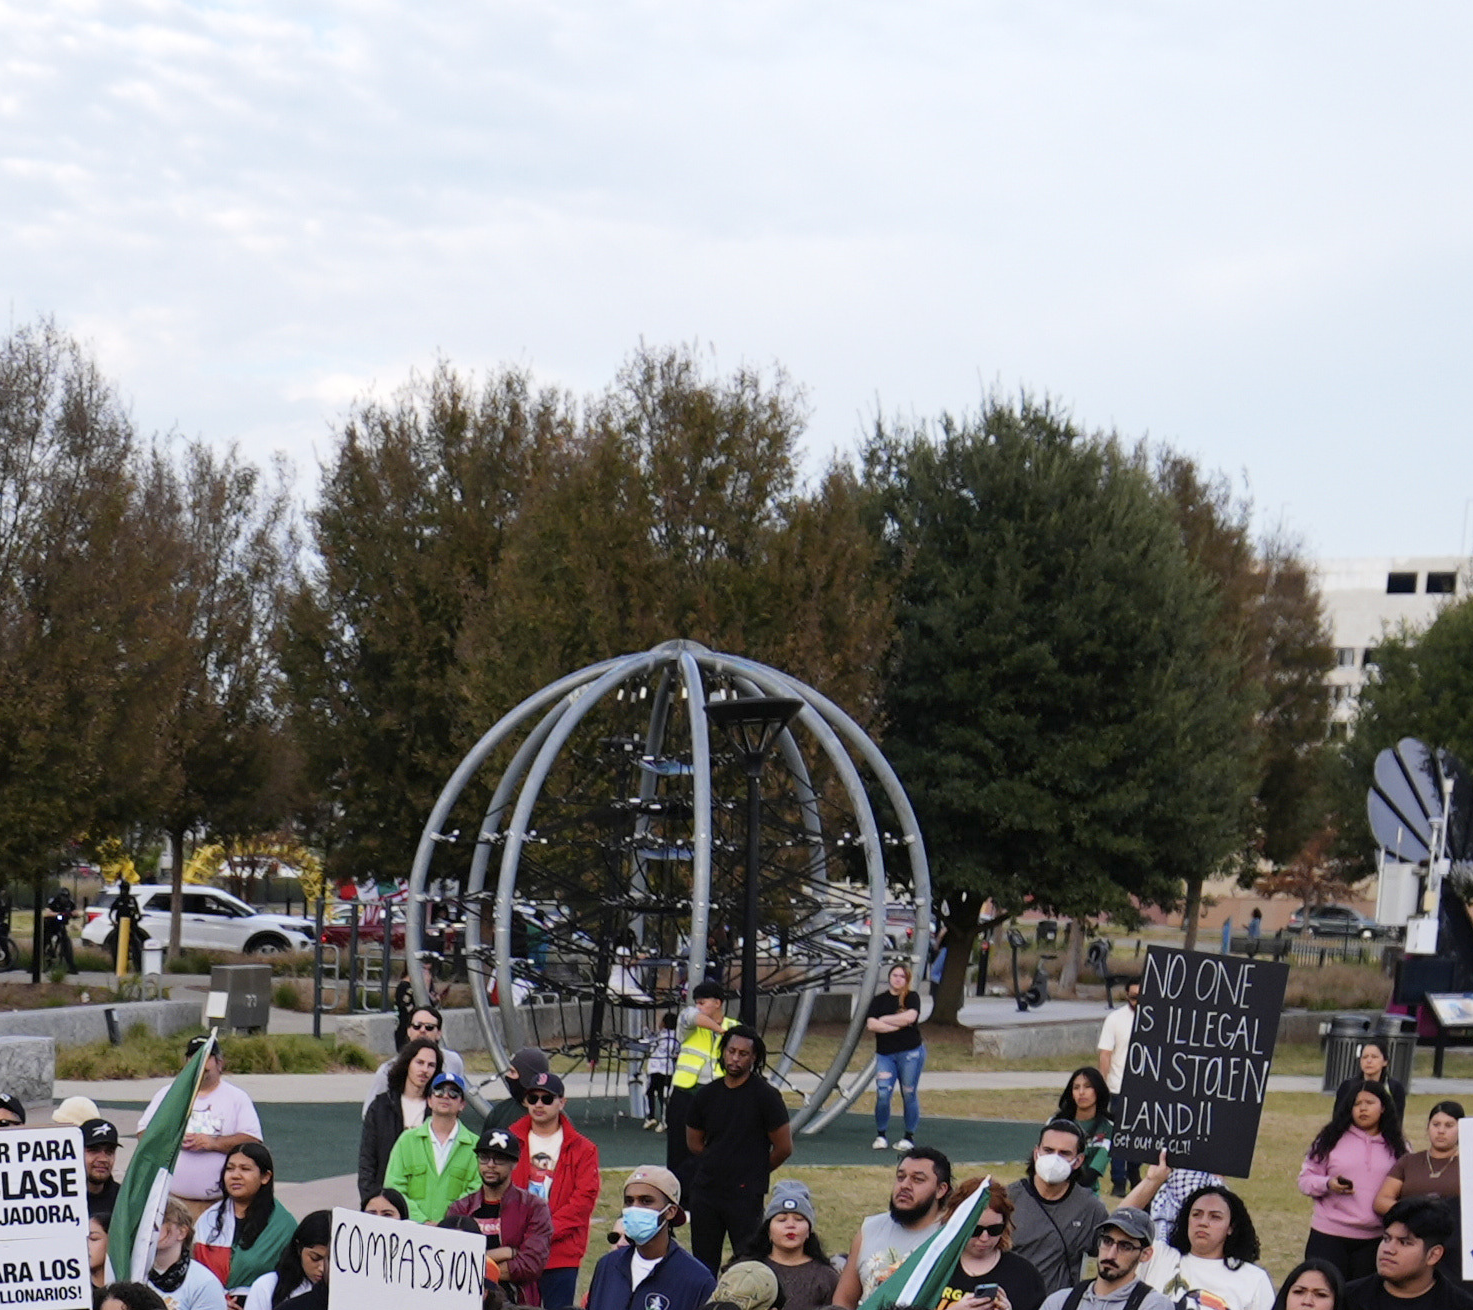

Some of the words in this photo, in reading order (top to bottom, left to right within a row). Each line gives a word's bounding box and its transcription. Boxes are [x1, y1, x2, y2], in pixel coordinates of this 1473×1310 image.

[1142, 953, 1187, 1000] NO
[1195, 958, 1256, 1009] ONE
[1134, 1003, 1154, 1033] IS
[1167, 1005, 1263, 1055] ILLEGAL
[1129, 1042, 1162, 1082] ON
[1166, 1052, 1269, 1104] STOLEN
[1120, 1096, 1212, 1142] LAND!!
[17, 1139, 76, 1164] PARA
[1133, 1136, 1154, 1150] out
[1168, 1140, 1191, 1155] CLT!
[40, 1259, 81, 1281] LOS
[334, 1222, 486, 1296] COMPASSION
